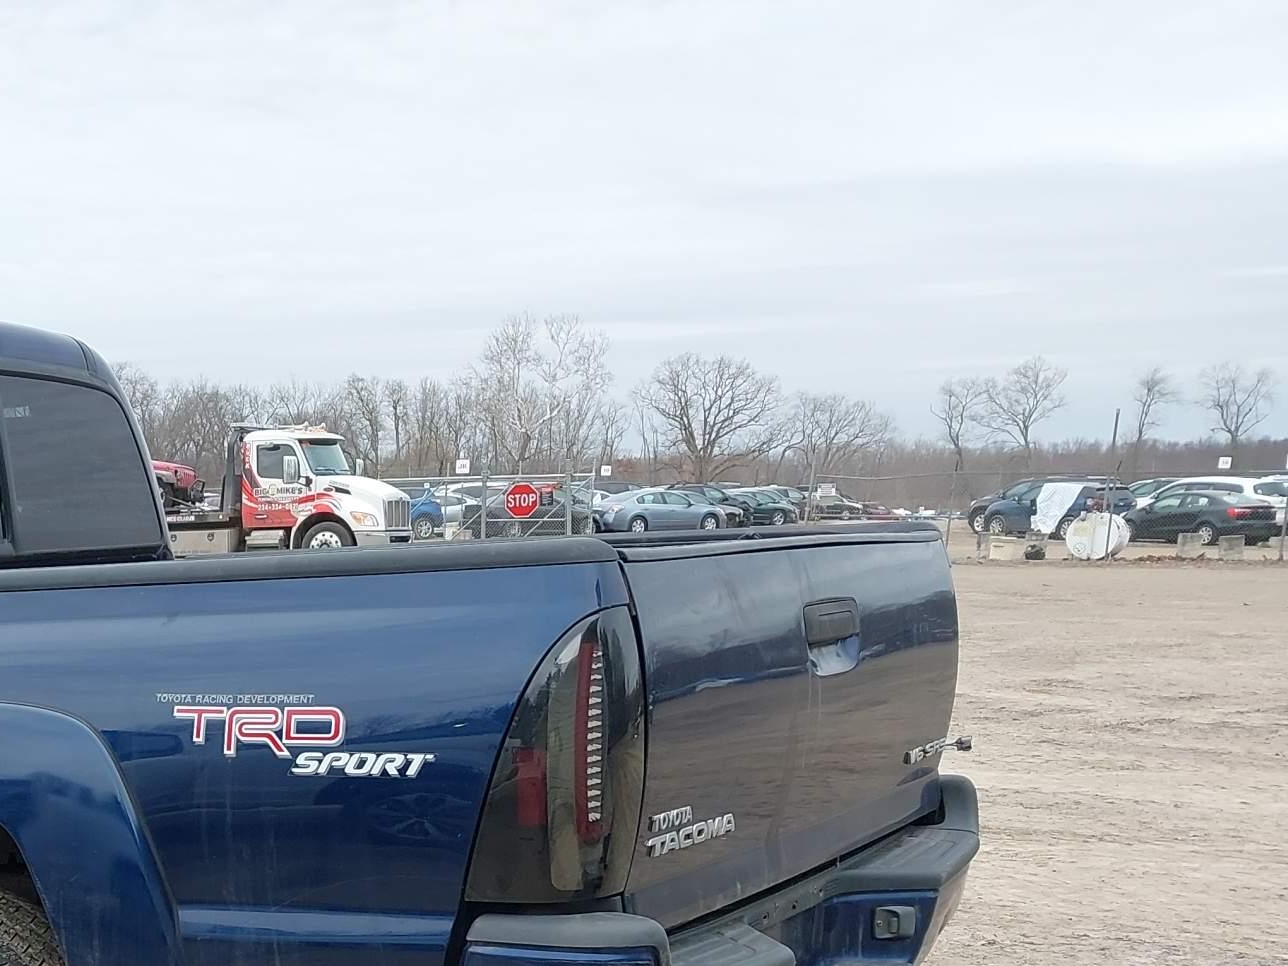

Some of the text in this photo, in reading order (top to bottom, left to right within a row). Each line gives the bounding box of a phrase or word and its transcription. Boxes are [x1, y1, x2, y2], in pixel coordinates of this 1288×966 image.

[276, 486, 303, 495] MIKE'S
[507, 493, 537, 508] STOP
[156, 693, 314, 704] TOYOTA RACING DEVELOPMENT
[174, 706, 346, 758] TRD
[289, 751, 437, 777] SPORT
[649, 805, 693, 832] TOYOTA
[646, 813, 736, 857] TACOMA
